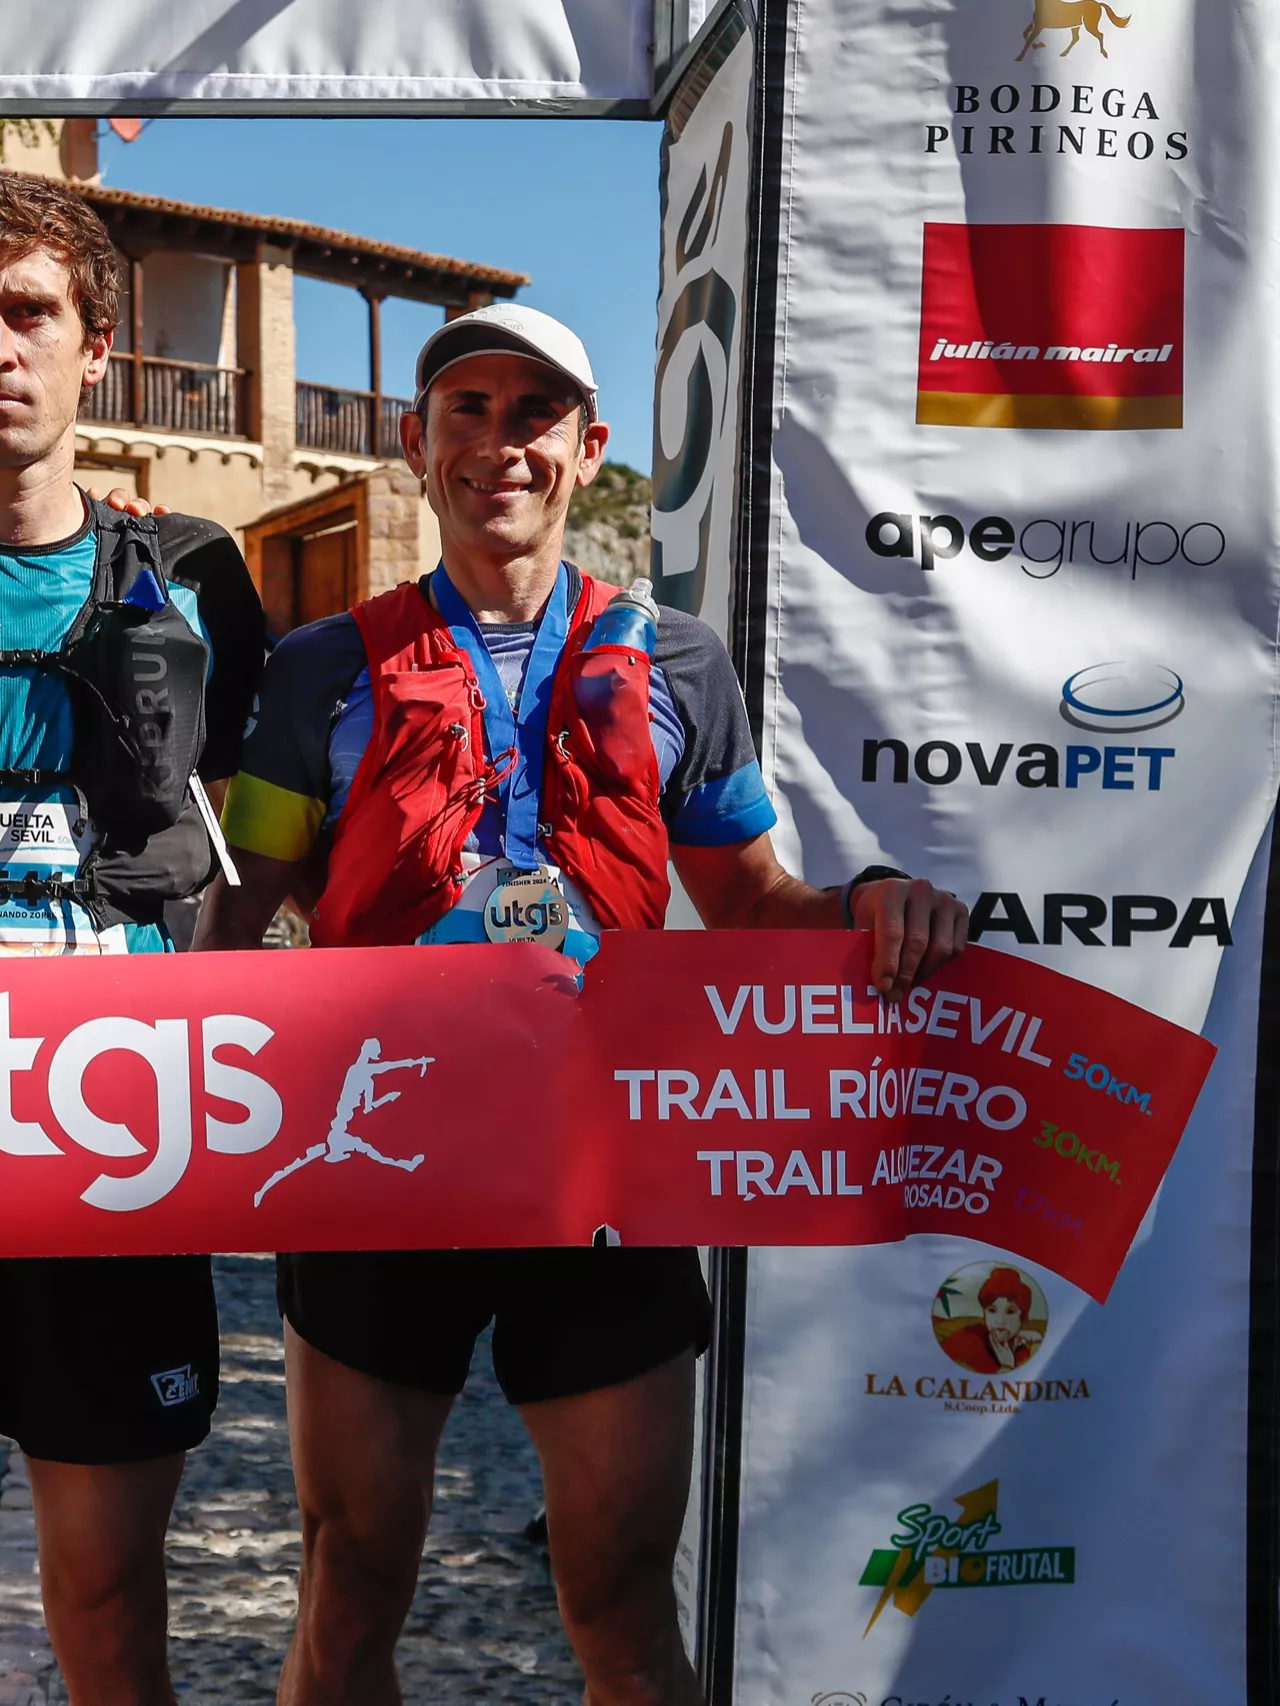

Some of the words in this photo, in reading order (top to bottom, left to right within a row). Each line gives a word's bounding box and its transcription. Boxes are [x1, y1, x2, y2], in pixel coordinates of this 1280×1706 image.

[954, 83, 1160, 120] BODEGA
[924, 124, 1189, 161] PIRINEOS
[929, 338, 1037, 362] julián
[1043, 343, 1174, 364] mairal
[861, 736, 1176, 791] novaPET
[11, 830, 55, 843] SEVIL
[490, 899, 563, 936] utgs
[969, 892, 1234, 948] ARPA
[704, 984, 902, 1035] VUELTA
[905, 985, 1052, 1068] SEVIL
[614, 1068, 810, 1121] TRAIL
[830, 1056, 899, 1121] RÍO
[901, 1067, 1027, 1131] VERO
[697, 1149, 862, 1197] TRAIL
[864, 1374, 907, 1397] LA
[915, 1376, 1090, 1402] CALANDINA
[889, 1503, 1002, 1564] Sport
